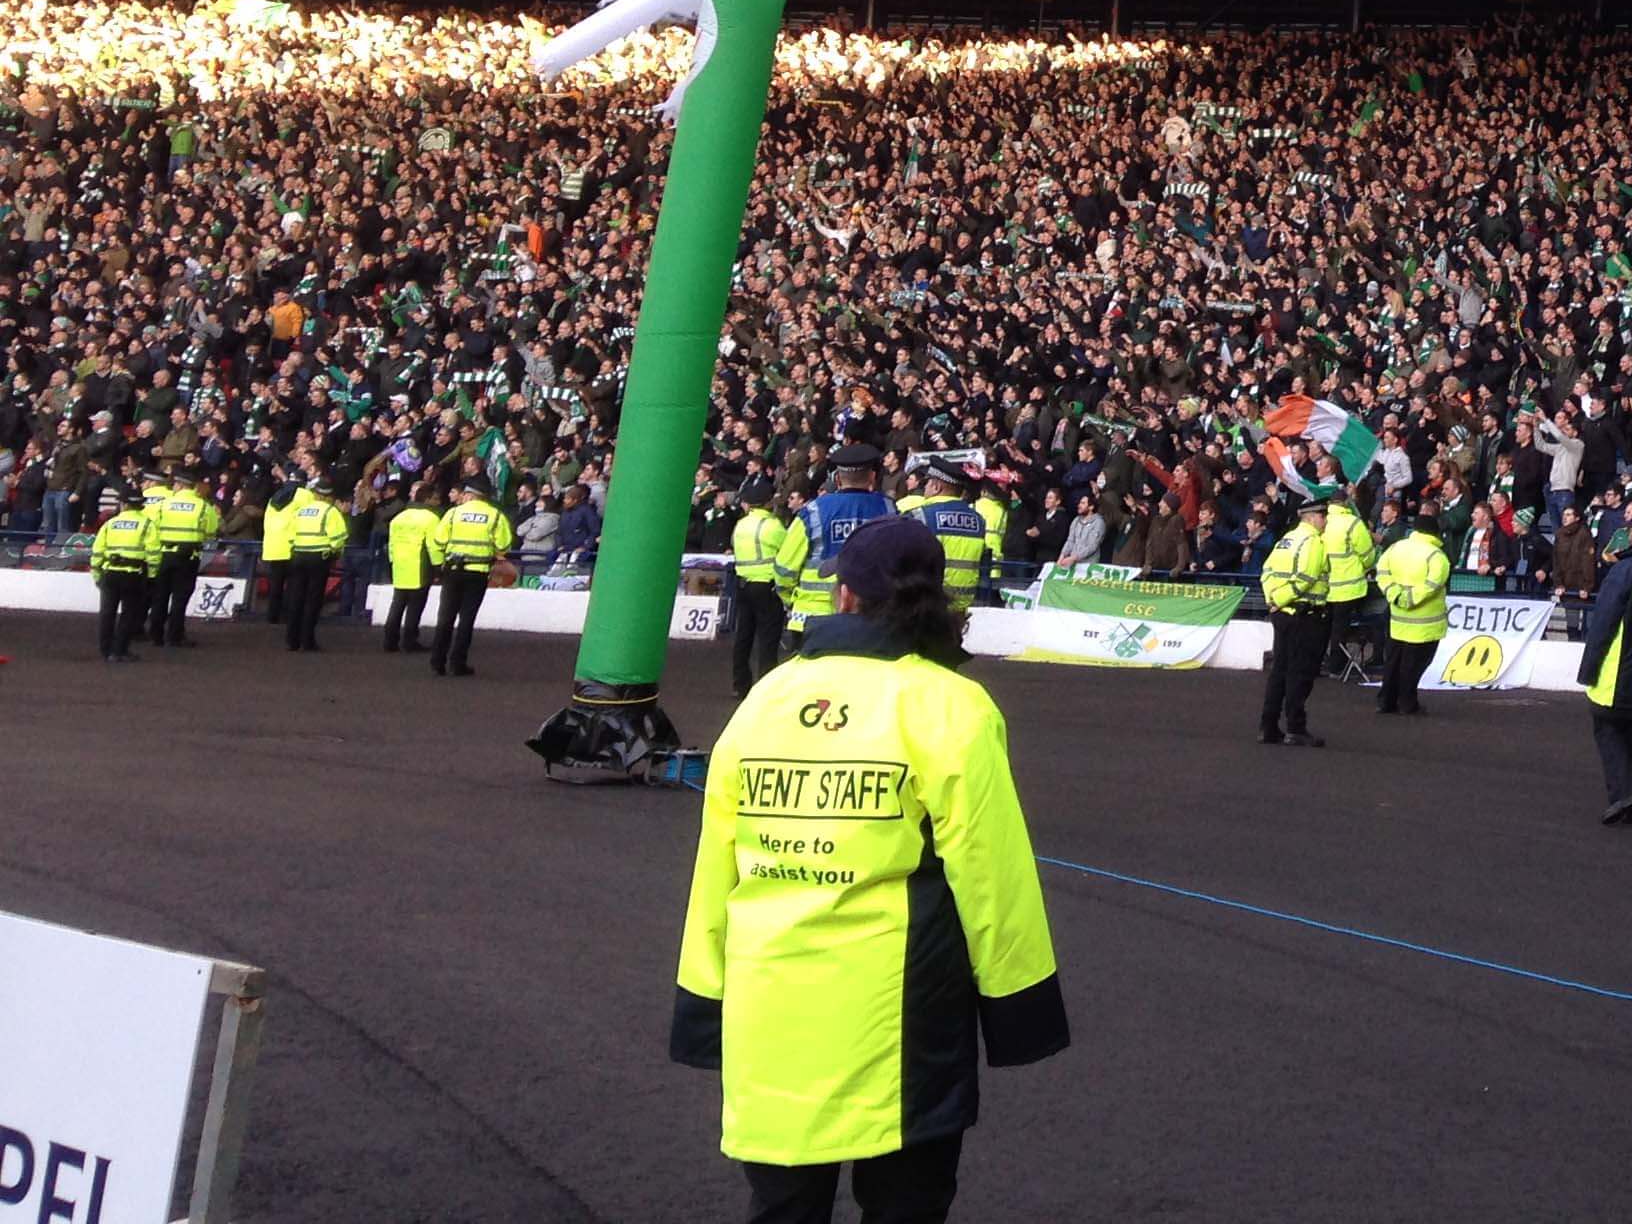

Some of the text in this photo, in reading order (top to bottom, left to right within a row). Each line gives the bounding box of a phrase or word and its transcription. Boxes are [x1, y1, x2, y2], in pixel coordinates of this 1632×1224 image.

[938, 513, 978, 529] POLICE
[201, 589, 228, 612] 34
[1139, 582, 1232, 600] RAFFERTY
[684, 608, 711, 633] 35
[1123, 602, 1157, 617] CSC
[1447, 603, 1531, 632] CELTIC
[816, 769, 892, 810] STAFF
[759, 832, 835, 855] Here to
[750, 863, 855, 886] assist you
